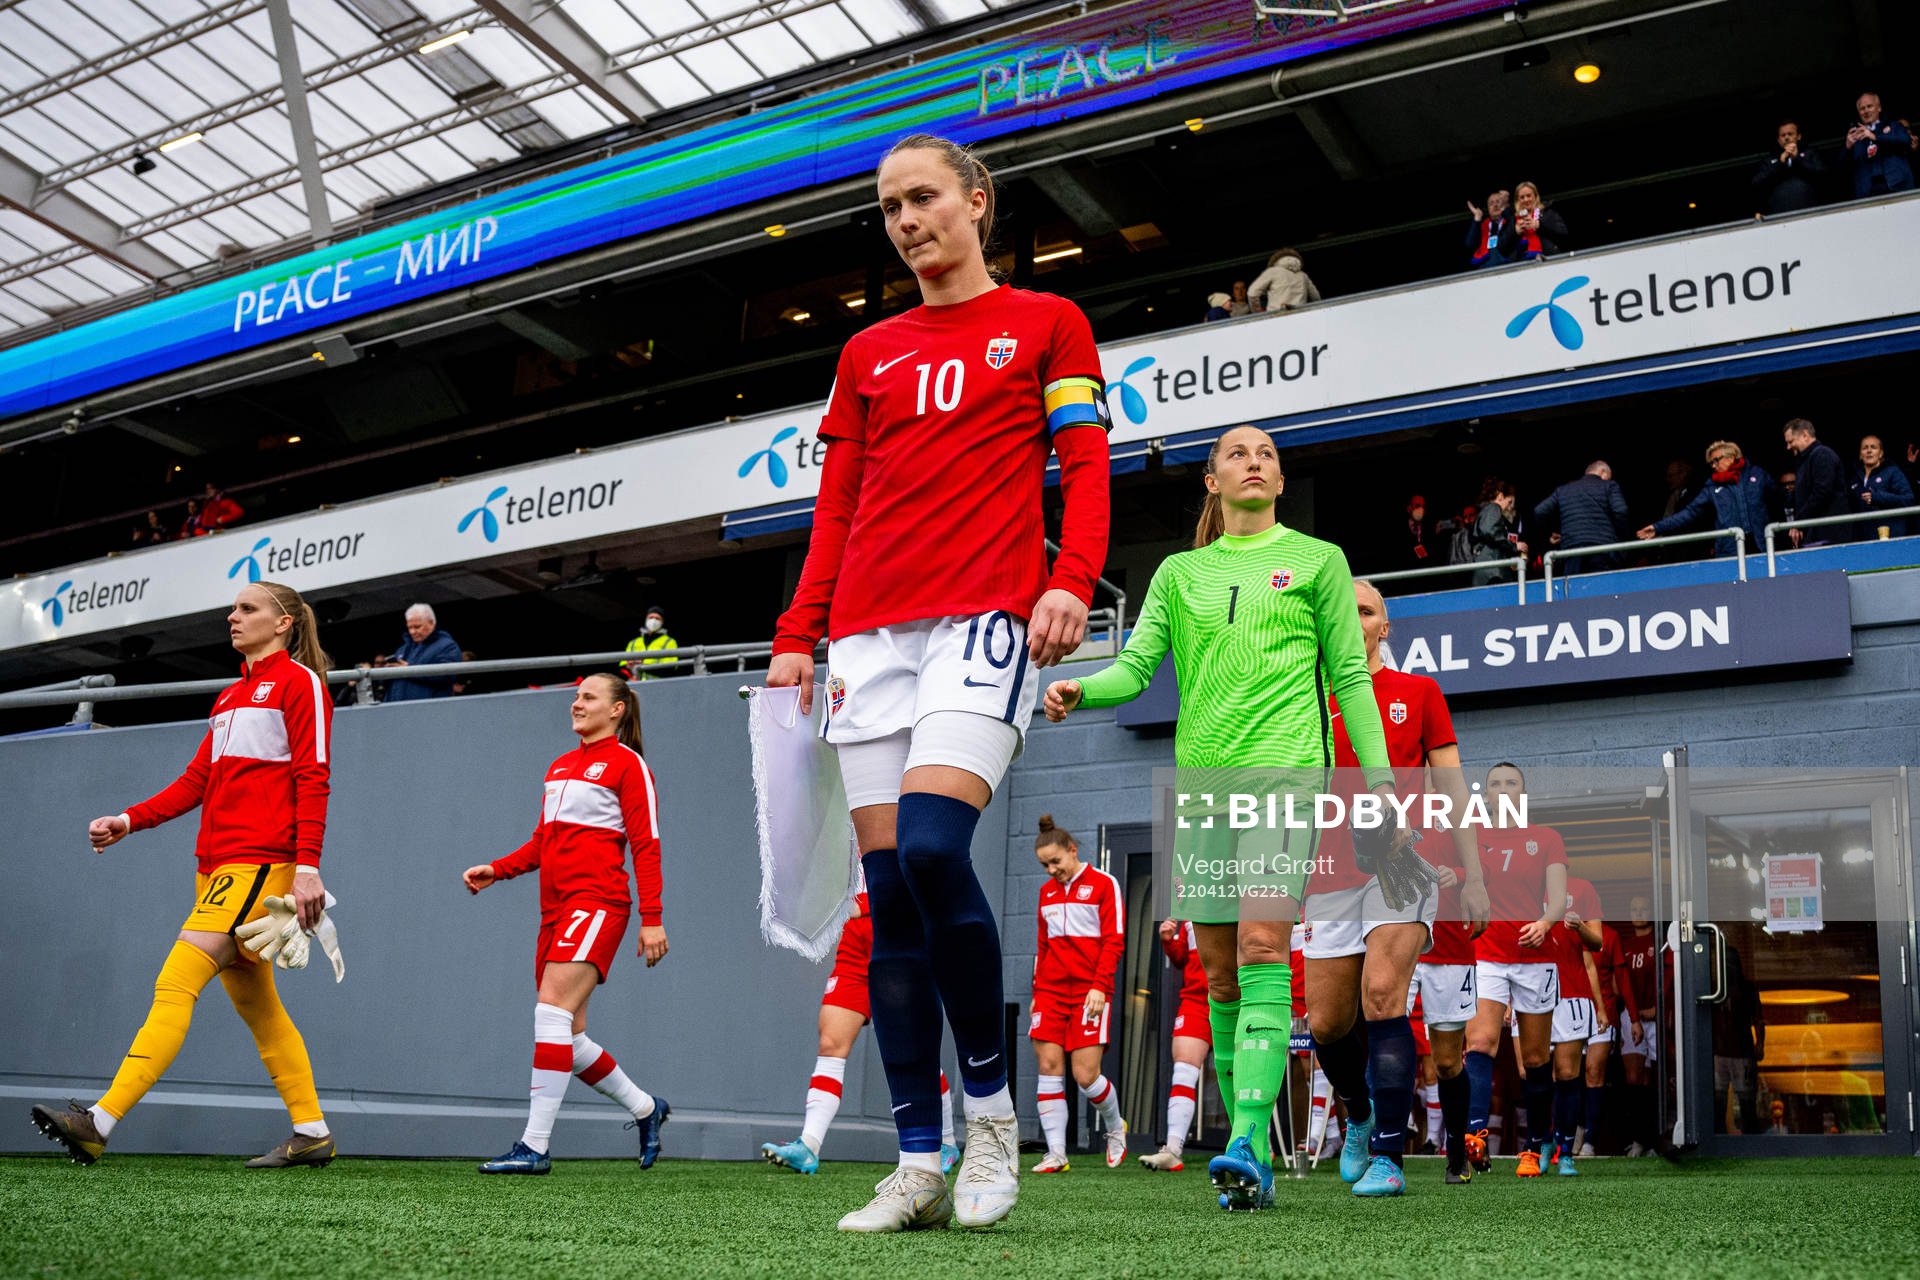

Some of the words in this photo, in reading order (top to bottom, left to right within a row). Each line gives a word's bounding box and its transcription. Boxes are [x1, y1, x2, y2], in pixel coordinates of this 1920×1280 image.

[978, 24, 1177, 116] PEACE
[233, 257, 353, 333] PEACE
[394, 215, 498, 285] МИР
[1589, 259, 1801, 326] telenor
[915, 358, 966, 416] 10
[1153, 343, 1328, 403] telenor
[506, 479, 623, 525] telenor
[268, 532, 365, 573] telenor
[68, 577, 150, 614] telenor
[1227, 585, 1240, 624] 1
[962, 609, 1016, 669] 10
[1482, 605, 1730, 667] STADION
[1500, 849, 1514, 872] 7
[202, 875, 234, 906] 12
[563, 909, 591, 939] 7
[1544, 968, 1554, 993] 7
[1631, 953, 1644, 969] 18
[1460, 967, 1472, 996] 4
[1567, 998, 1584, 1021] 11
